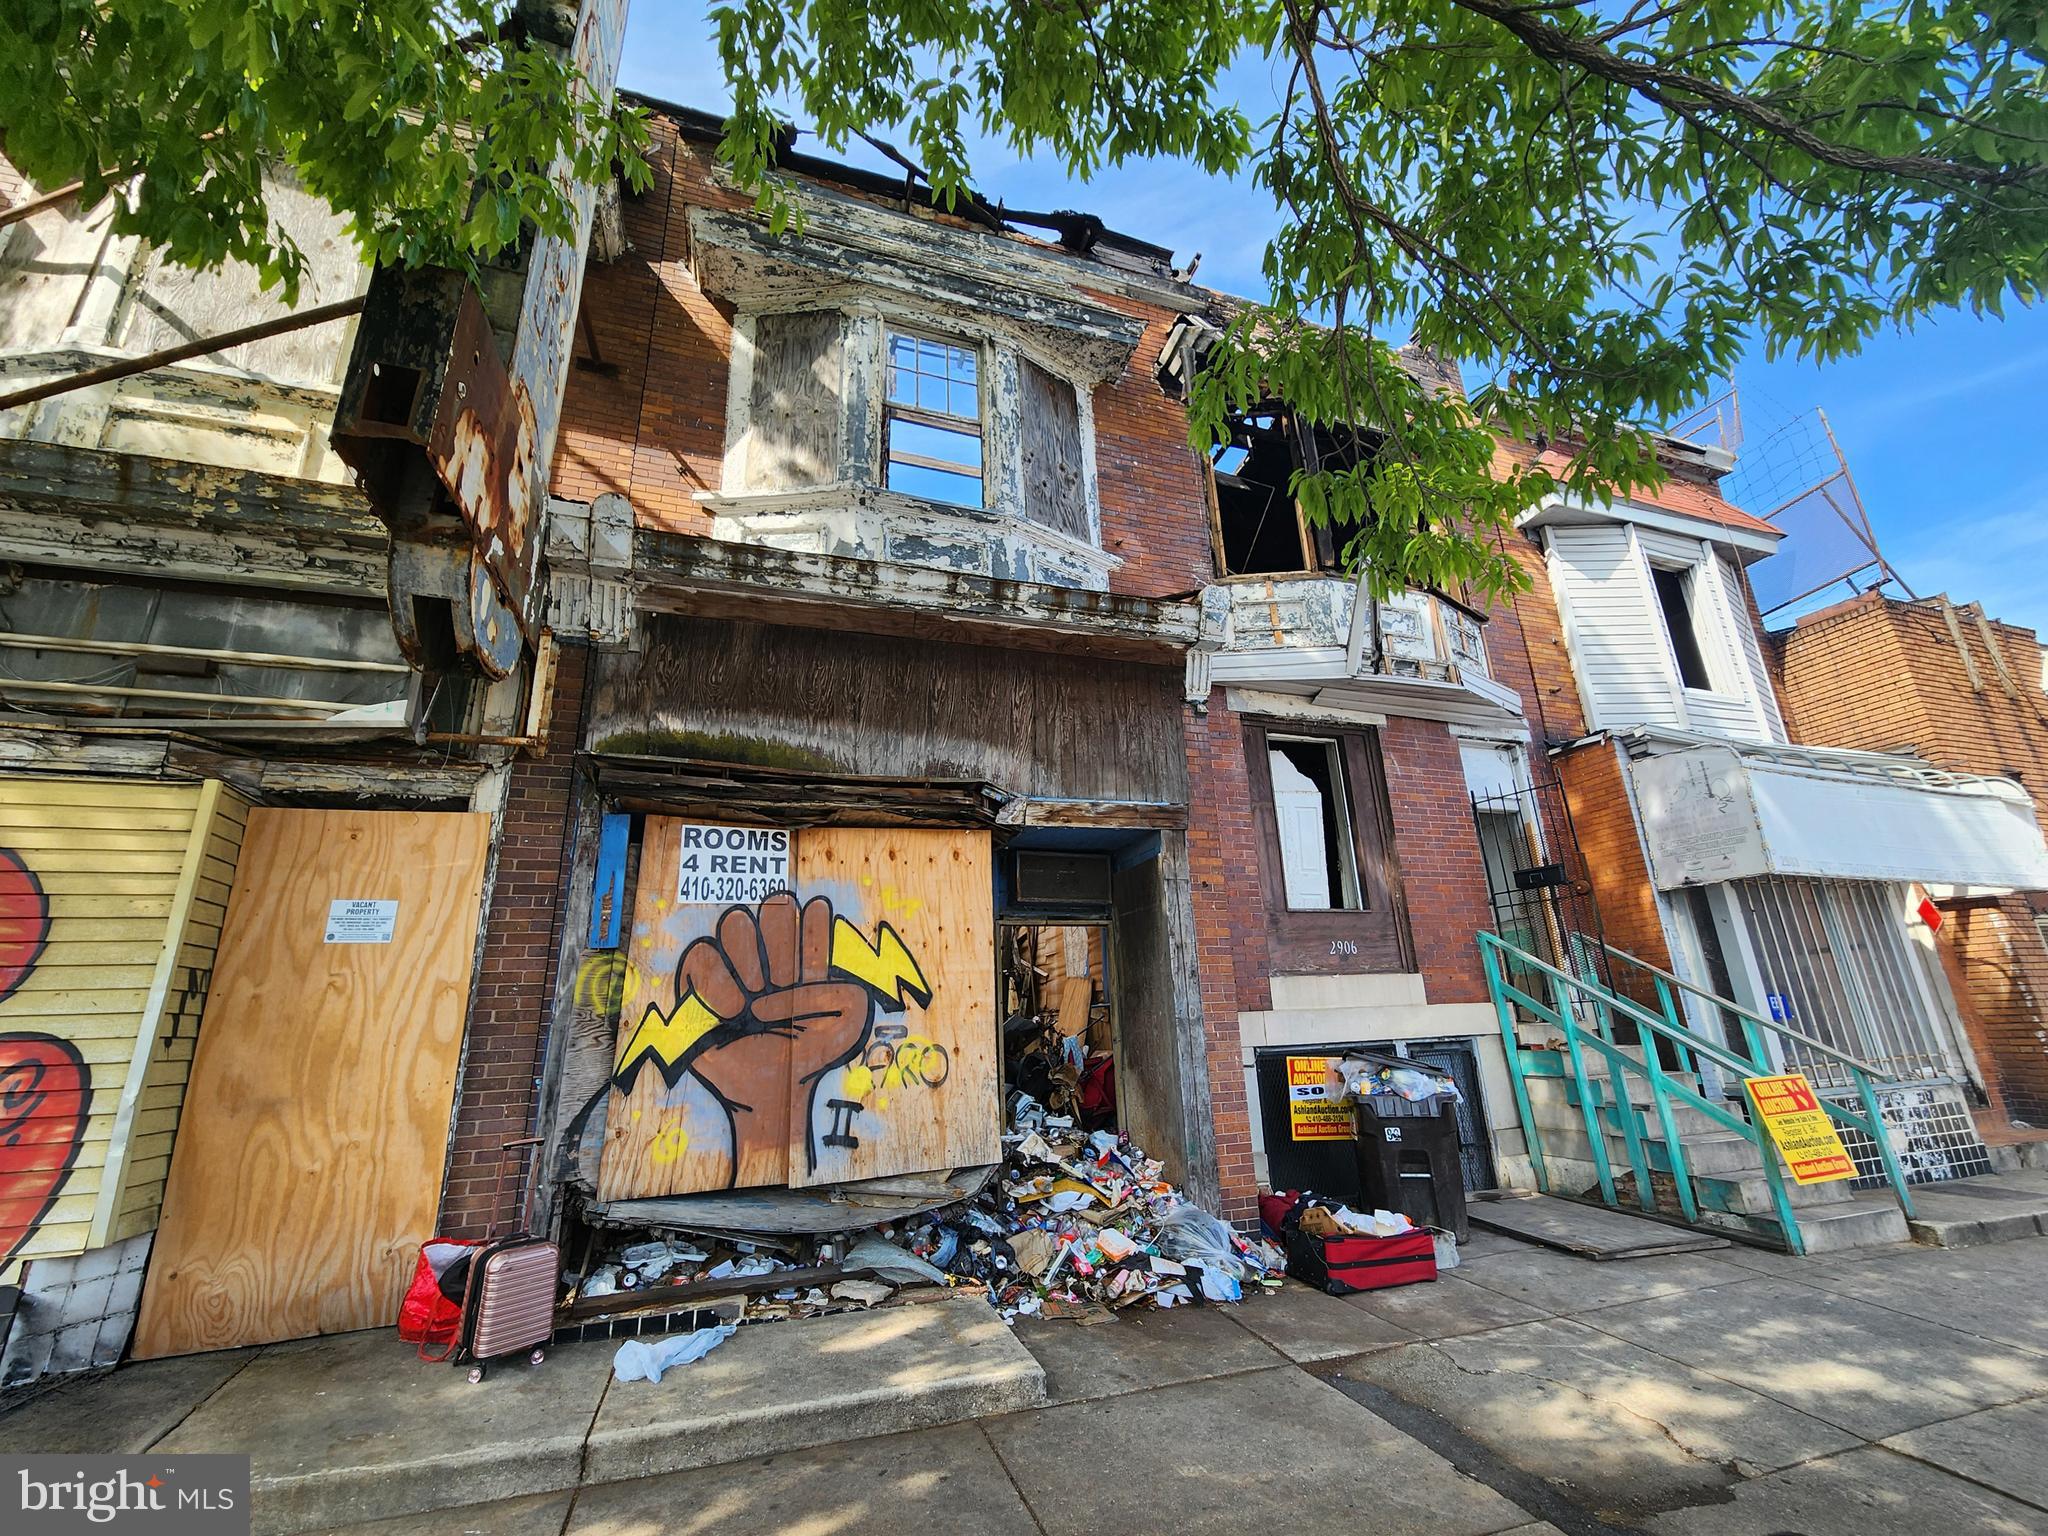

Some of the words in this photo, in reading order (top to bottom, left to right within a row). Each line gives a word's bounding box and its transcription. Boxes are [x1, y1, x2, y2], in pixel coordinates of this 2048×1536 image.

[684, 828, 787, 851] ROOMS
[683, 854, 699, 872] 4
[710, 855, 786, 874] RENT
[1330, 940, 1358, 954] 2906
[1294, 1060, 1325, 1072] ONLINE
[1754, 1081, 1789, 1098] ONLINE
[1761, 1096, 1799, 1114] AUCTION
[1338, 1124, 1351, 1132] Grou
